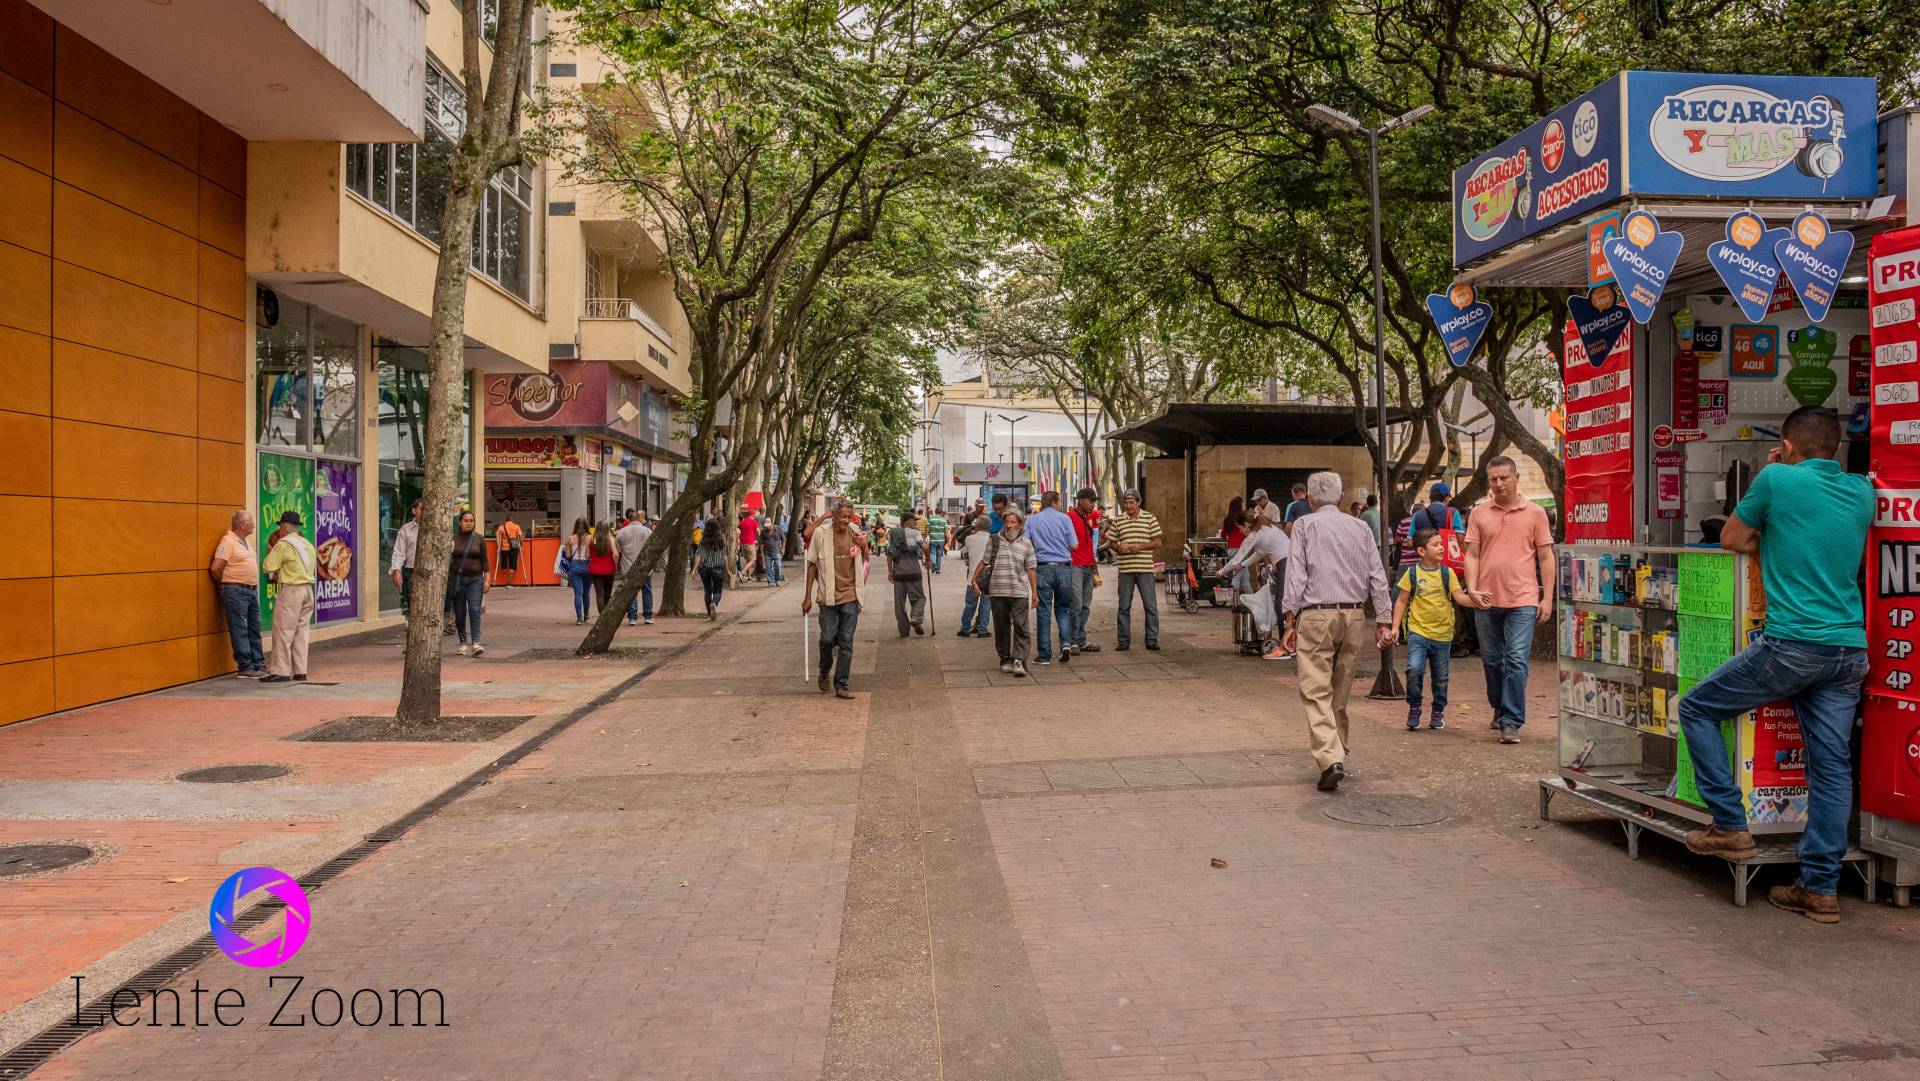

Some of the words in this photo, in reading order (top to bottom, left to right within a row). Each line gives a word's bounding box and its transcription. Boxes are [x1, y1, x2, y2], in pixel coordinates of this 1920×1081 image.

[1666, 99, 1829, 126] RECARGAS
[1542, 138, 1563, 158] Claro
[1684, 130, 1707, 153] Y
[1727, 128, 1796, 164] MAS
[1466, 151, 1526, 198] RECARGAS
[1537, 160, 1608, 219] ACCESORIOS
[1472, 202, 1480, 223] Y
[1613, 243, 1665, 280] Wplay.co
[1718, 246, 1776, 278] Wplay.co
[1785, 243, 1838, 278] Wplay.co
[1741, 290, 1767, 306] ahora!
[1804, 288, 1829, 306] ahora!
[1440, 307, 1484, 334] Wplay.co
[1580, 310, 1623, 335] Wplay.co
[1735, 340, 1750, 353] 4G
[1879, 344, 1912, 364] 10GB
[1742, 357, 1765, 370] AQUÍ
[488, 378, 582, 412] Superior
[1568, 384, 1578, 401] SIM
[1881, 384, 1909, 402] 5GB
[1568, 413, 1579, 432] SIM
[489, 455, 540, 464] Naturales
[1568, 442, 1580, 459] SIM
[1654, 455, 1684, 464] Avantel
[317, 579, 351, 599] AREPA
[1888, 608, 1915, 628] 1P
[1886, 639, 1912, 659] 2P
[1885, 670, 1912, 690] 4P
[1764, 722, 1776, 730] tus
